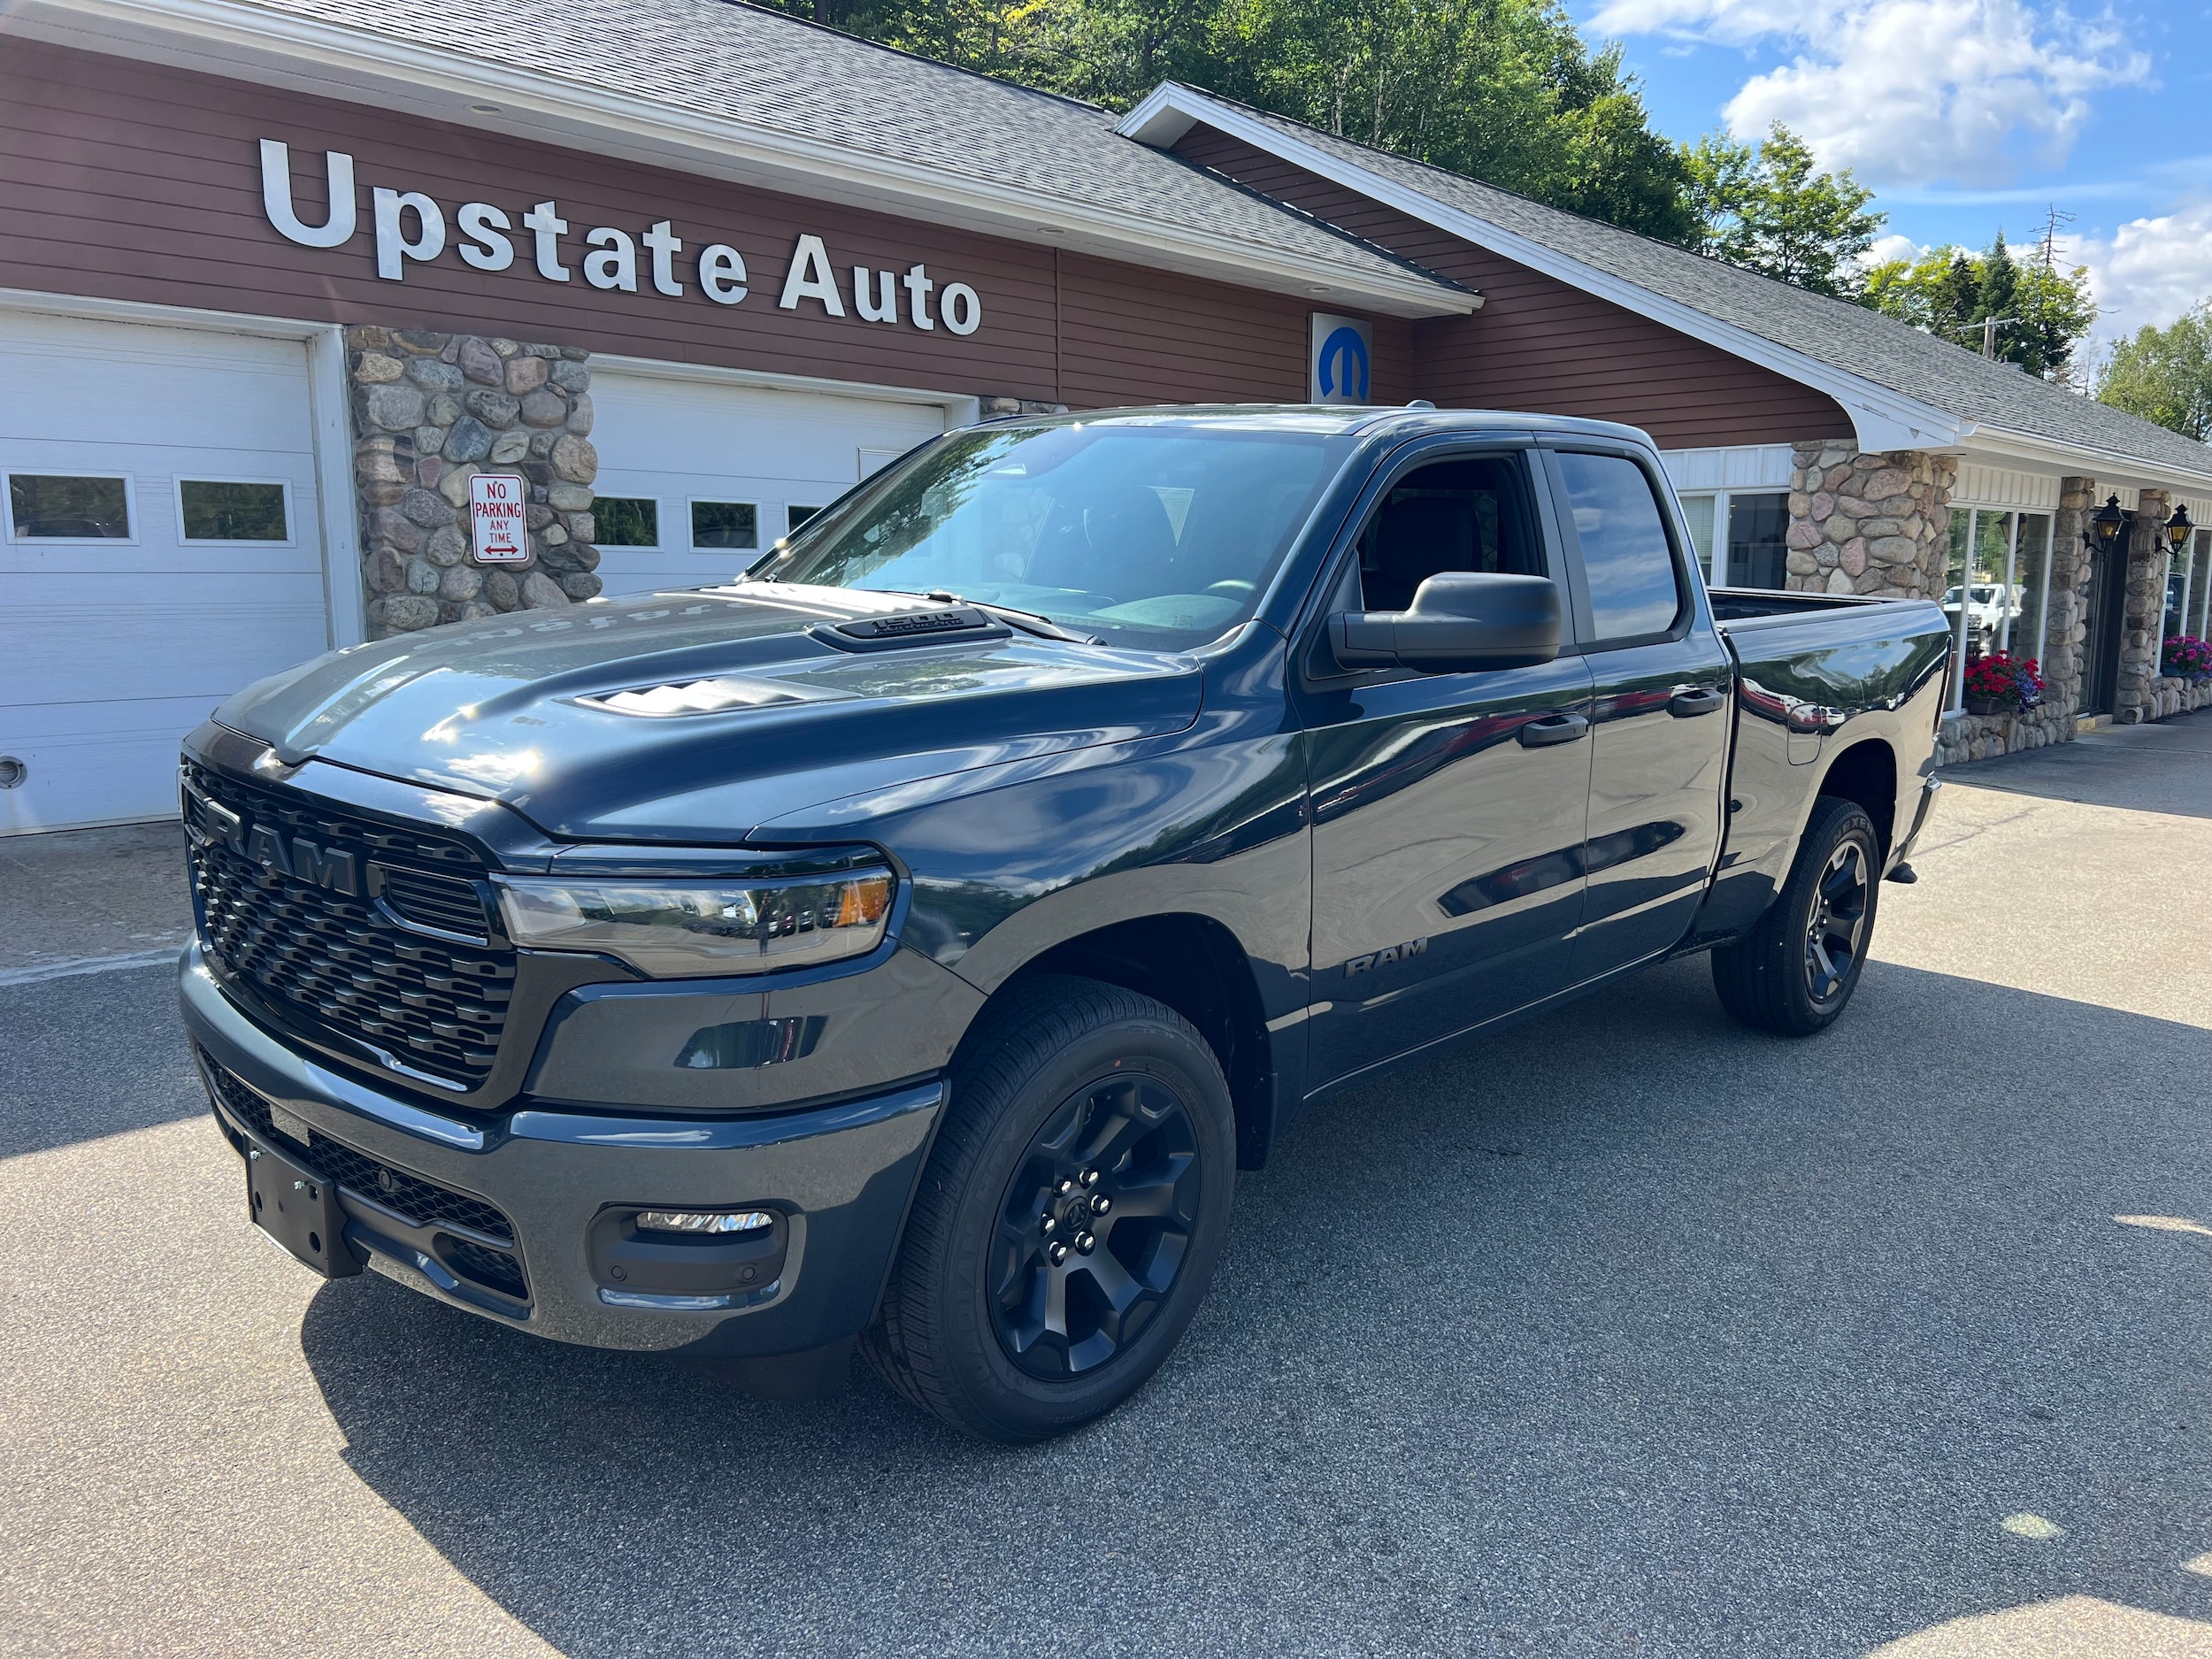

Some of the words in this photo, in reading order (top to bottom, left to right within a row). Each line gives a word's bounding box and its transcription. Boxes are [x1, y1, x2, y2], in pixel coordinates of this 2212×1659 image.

[259, 138, 749, 305] Upstate
[779, 233, 982, 336] Auto
[487, 483, 506, 499] NO
[475, 503, 521, 518] PARKING
[490, 520, 509, 531] ANY
[489, 533, 512, 543] TIME
[872, 612, 961, 628] 1500
[1832, 816, 1873, 845] NEXEN
[204, 797, 357, 897] RAM
[1343, 937, 1428, 979] RAM
